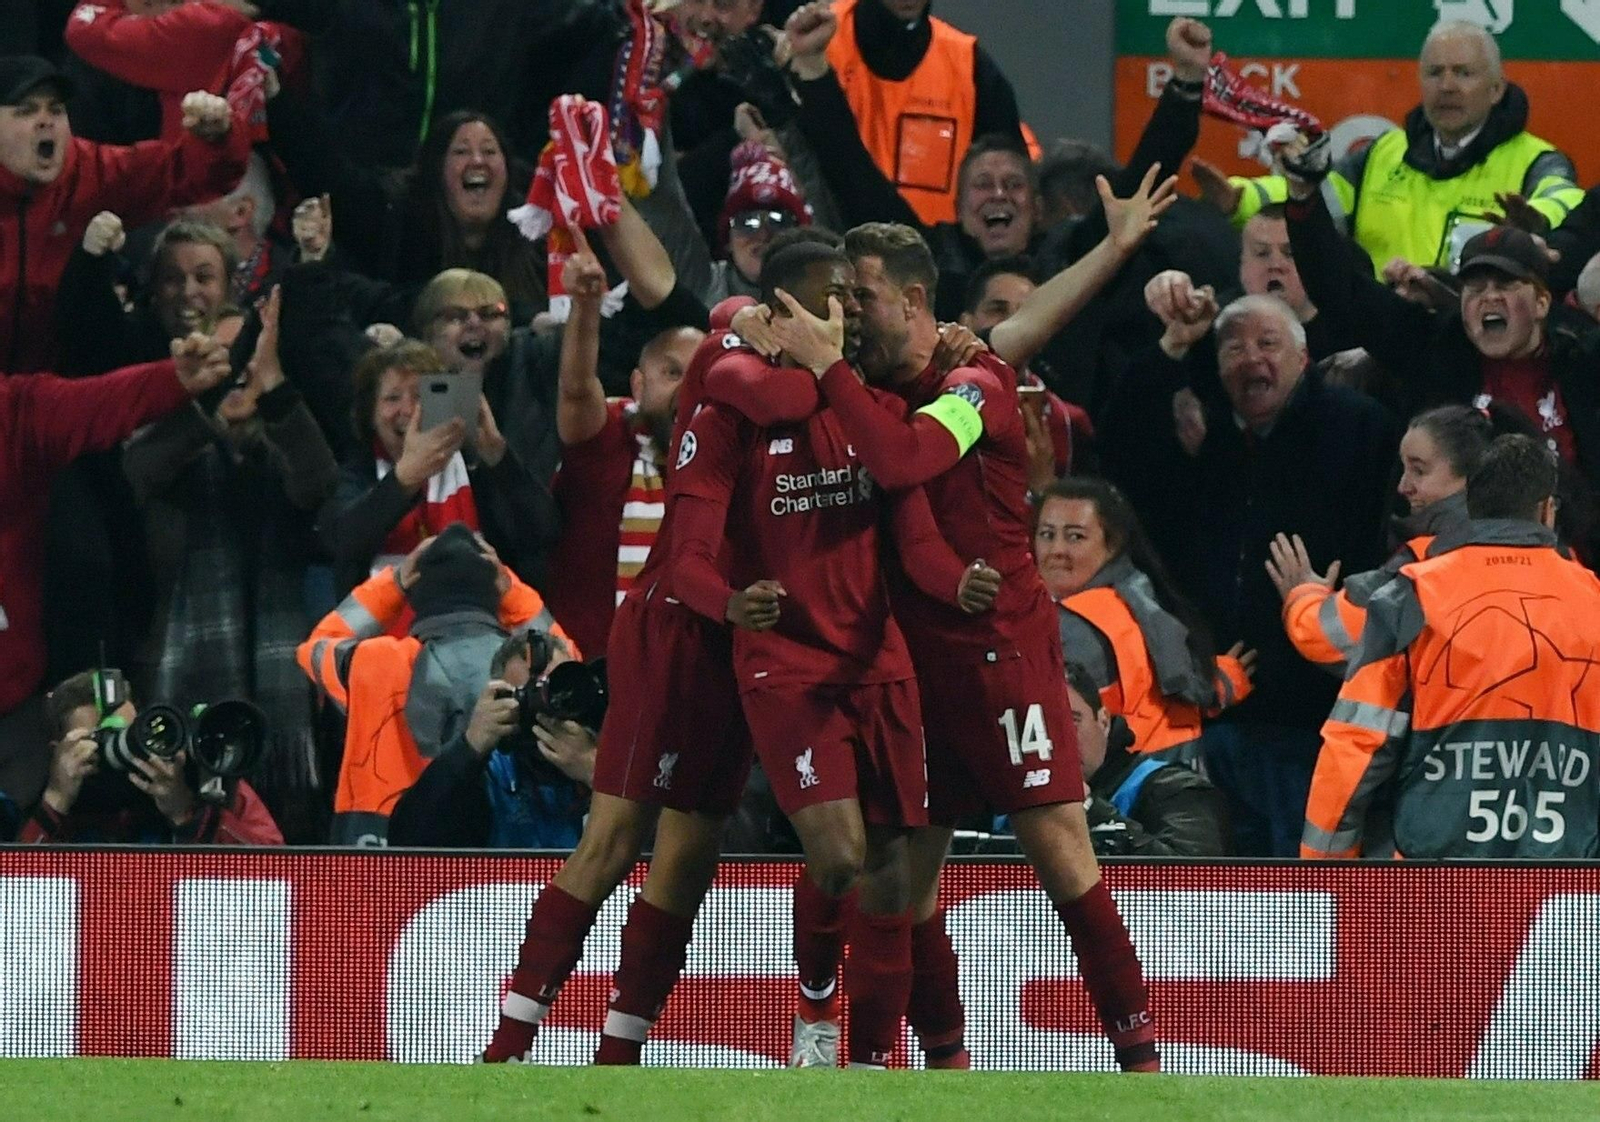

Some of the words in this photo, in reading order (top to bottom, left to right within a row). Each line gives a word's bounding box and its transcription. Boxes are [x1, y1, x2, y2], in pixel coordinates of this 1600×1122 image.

[775, 464, 853, 494] Standard
[998, 703, 1054, 766] 14
[1465, 788, 1566, 844] 565
